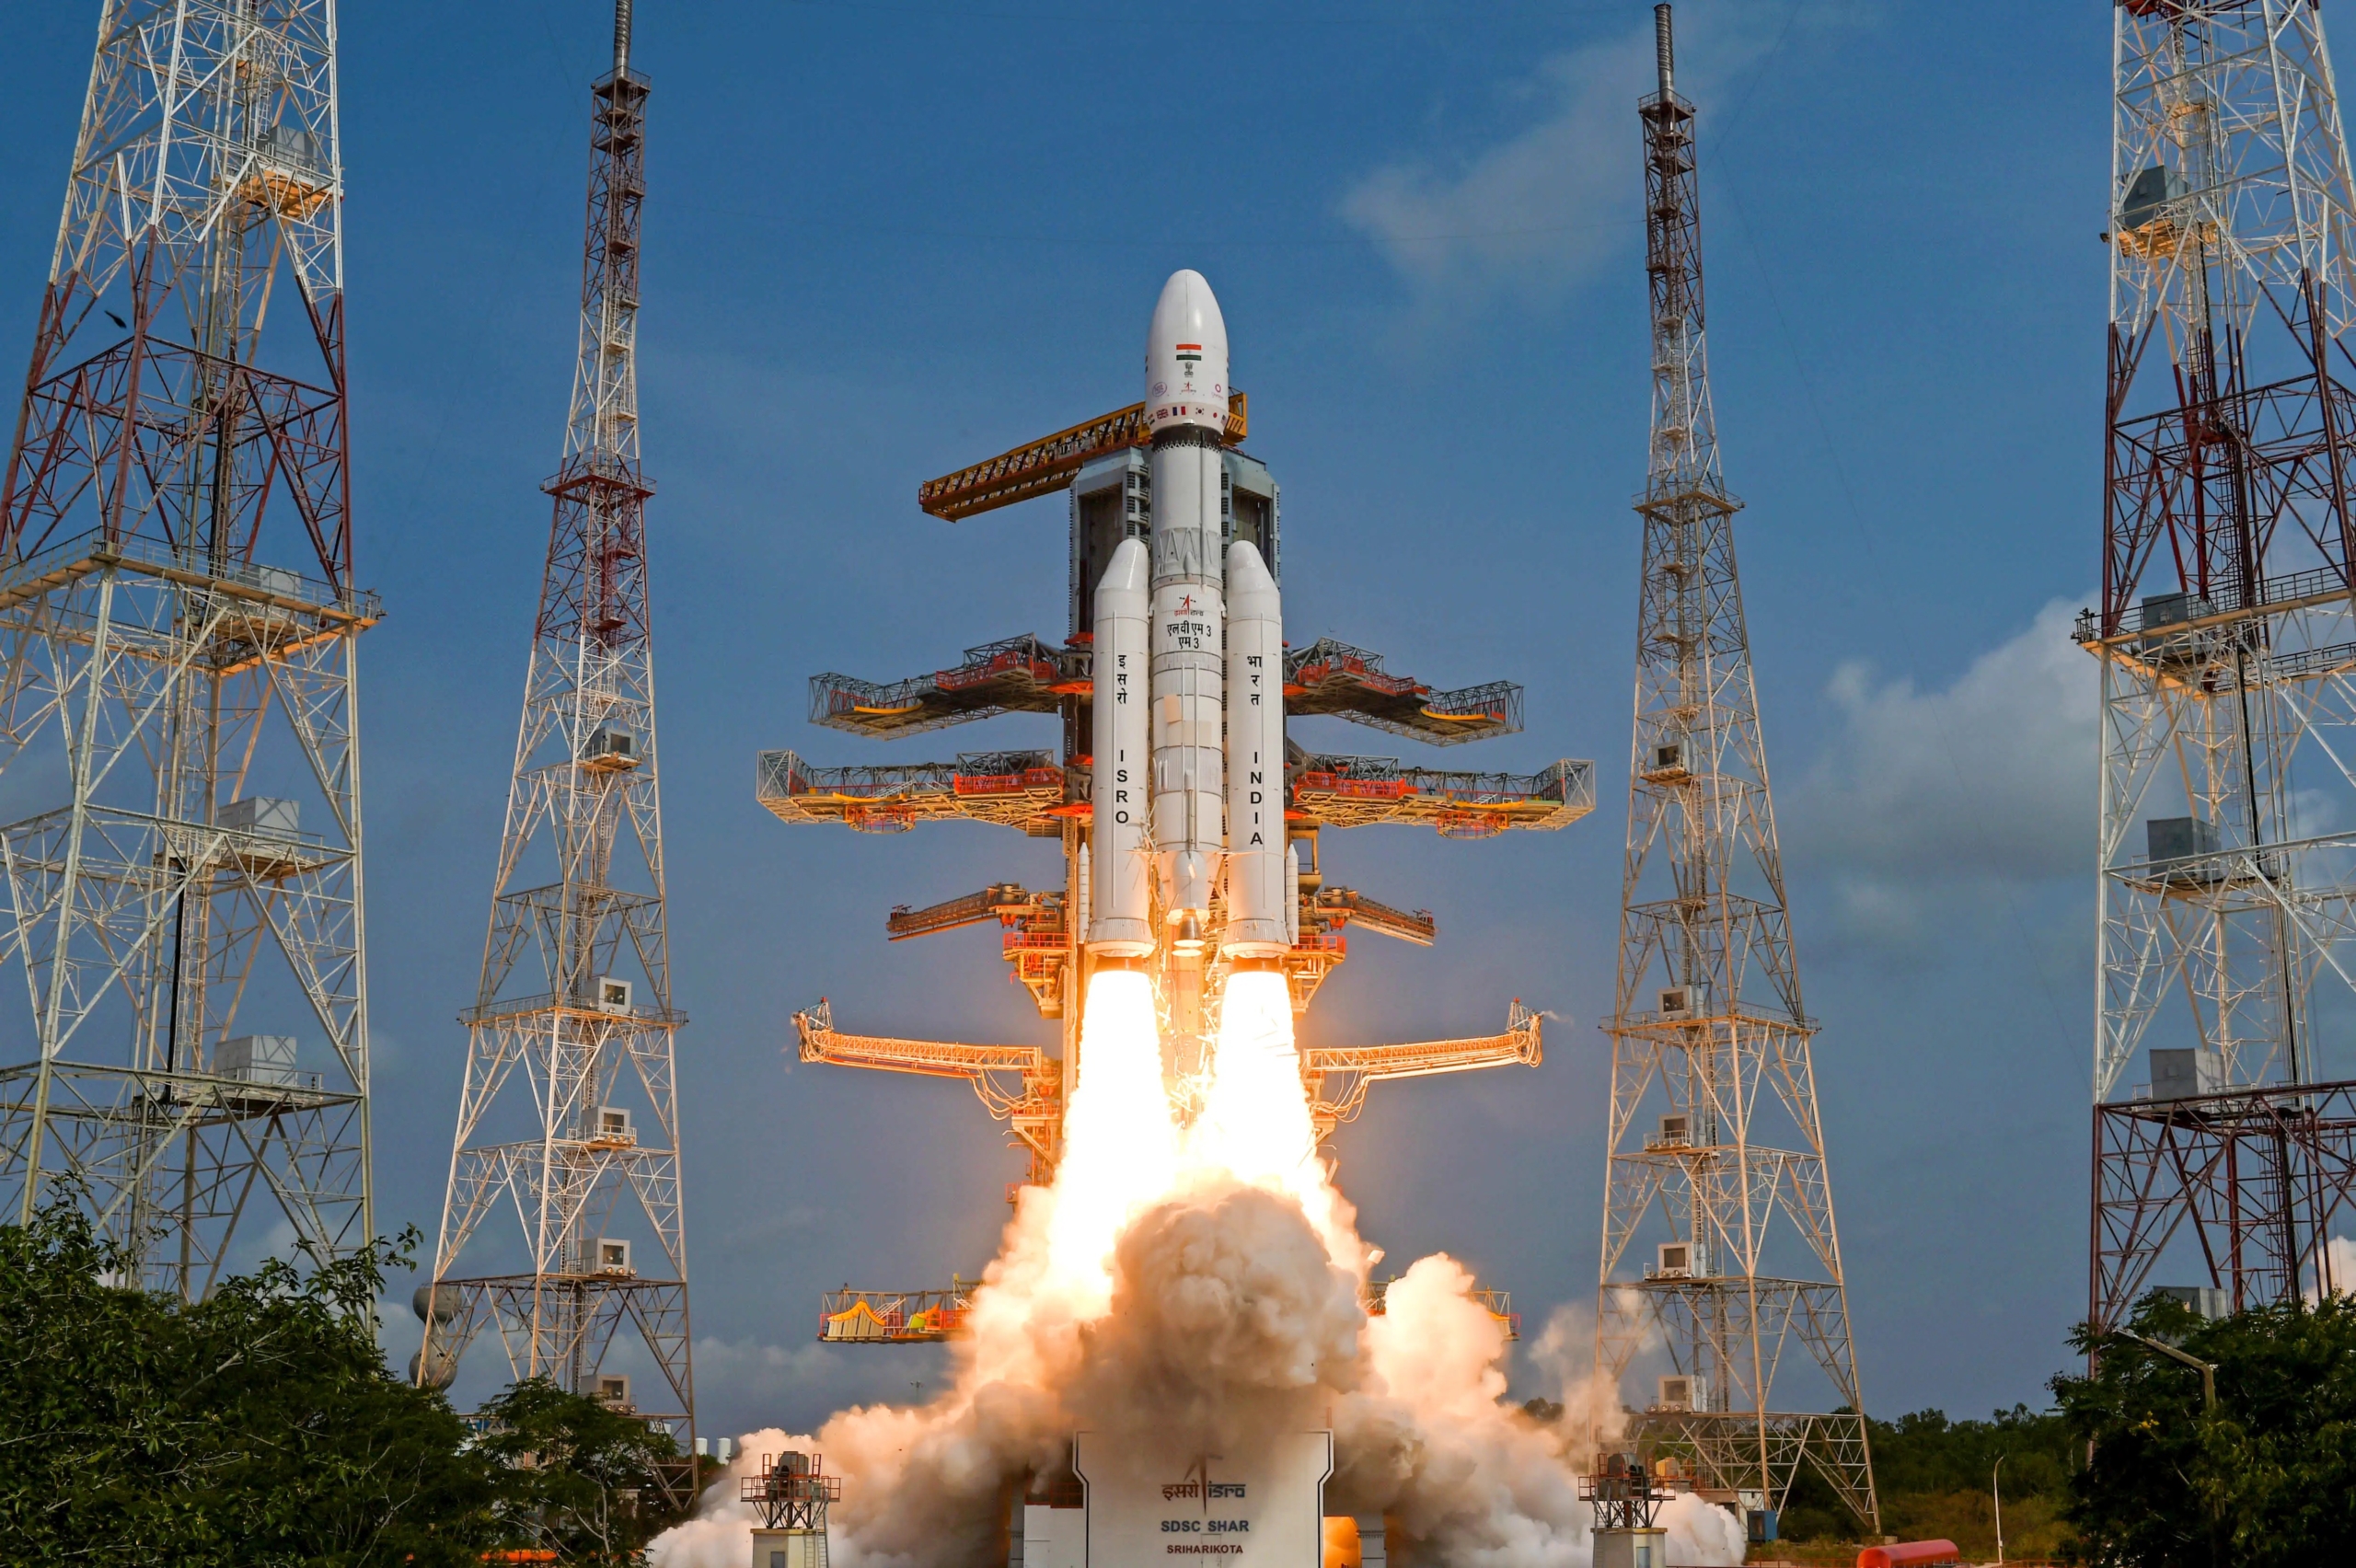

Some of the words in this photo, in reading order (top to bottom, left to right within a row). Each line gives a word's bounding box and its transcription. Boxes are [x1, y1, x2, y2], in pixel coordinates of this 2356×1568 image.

[1115, 749, 1129, 824] ISRO
[1250, 751, 1263, 845] INDIA
[1161, 1479, 1199, 1501] इसरो
[1161, 1520, 1201, 1532] SDSC
[1207, 1520, 1249, 1532] SHAR
[1167, 1544, 1243, 1554] SRIHARIKOTA
